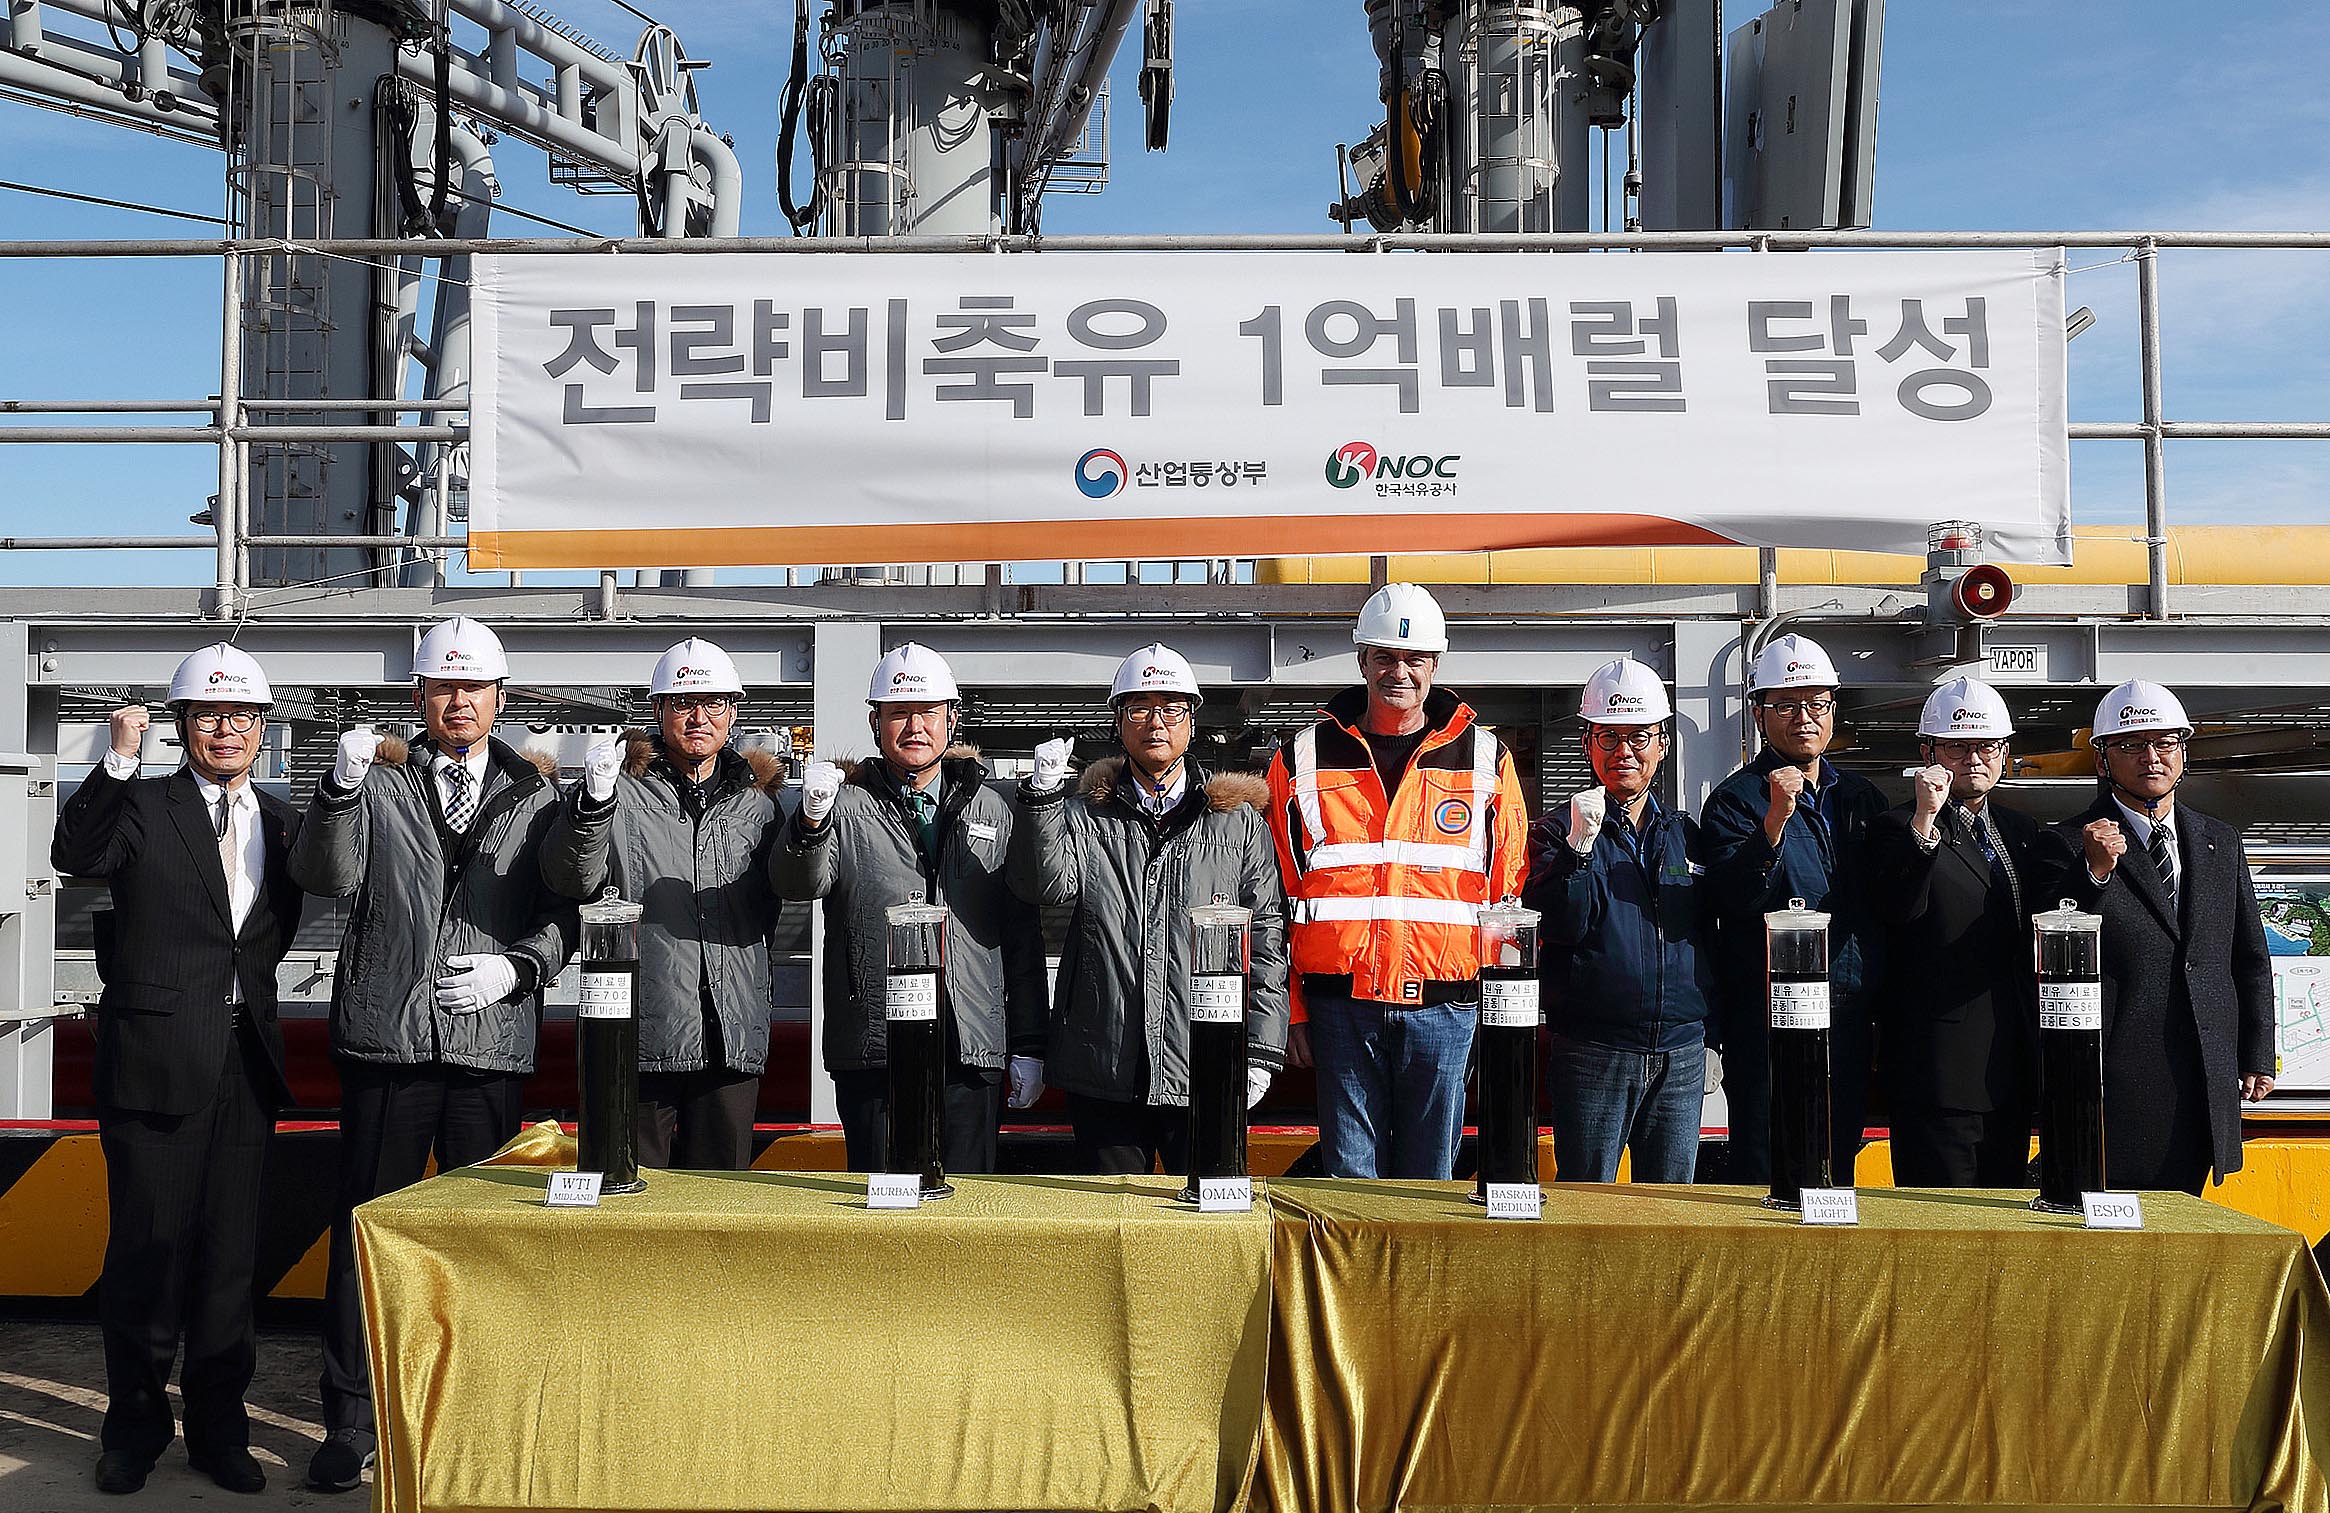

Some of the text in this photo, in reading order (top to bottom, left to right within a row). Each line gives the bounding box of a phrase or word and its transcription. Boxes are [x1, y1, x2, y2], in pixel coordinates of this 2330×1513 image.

[542, 293, 1994, 426] 전략비축유 1억배럴 달성
[1325, 441, 1462, 488] KNOC
[1135, 460, 1268, 488] 산업통상부
[1375, 482, 1458, 498] 한국석유공사
[1992, 650, 2034, 669] VAPOR
[1608, 693, 1643, 707] KNOC
[1952, 708, 1989, 721] KNOC
[2119, 705, 2158, 720] KNOC
[898, 977, 930, 989] 시료명
[1205, 979, 1237, 991] 시료명
[1484, 983, 1504, 995] 원유
[586, 990, 628, 1001] T-702
[1772, 985, 1793, 997] 원유
[2041, 985, 2061, 998] 원유
[892, 992, 932, 1003] T-203
[891, 1007, 934, 1018] Murban
[1197, 1008, 1240, 1019] OMAN
[562, 1177, 592, 1190] WTI
[552, 1192, 594, 1202] MIDLAND
[870, 1186, 918, 1197] MURBAN
[1202, 1187, 1248, 1201] OMAN
[1490, 1189, 1537, 1200] BASRAH
[1806, 1195, 1853, 1206] BASRAH
[1490, 1201, 1537, 1213] MEDIUM
[2091, 1204, 2135, 1218] ESPO
[1813, 1208, 1849, 1219] LIGHT
